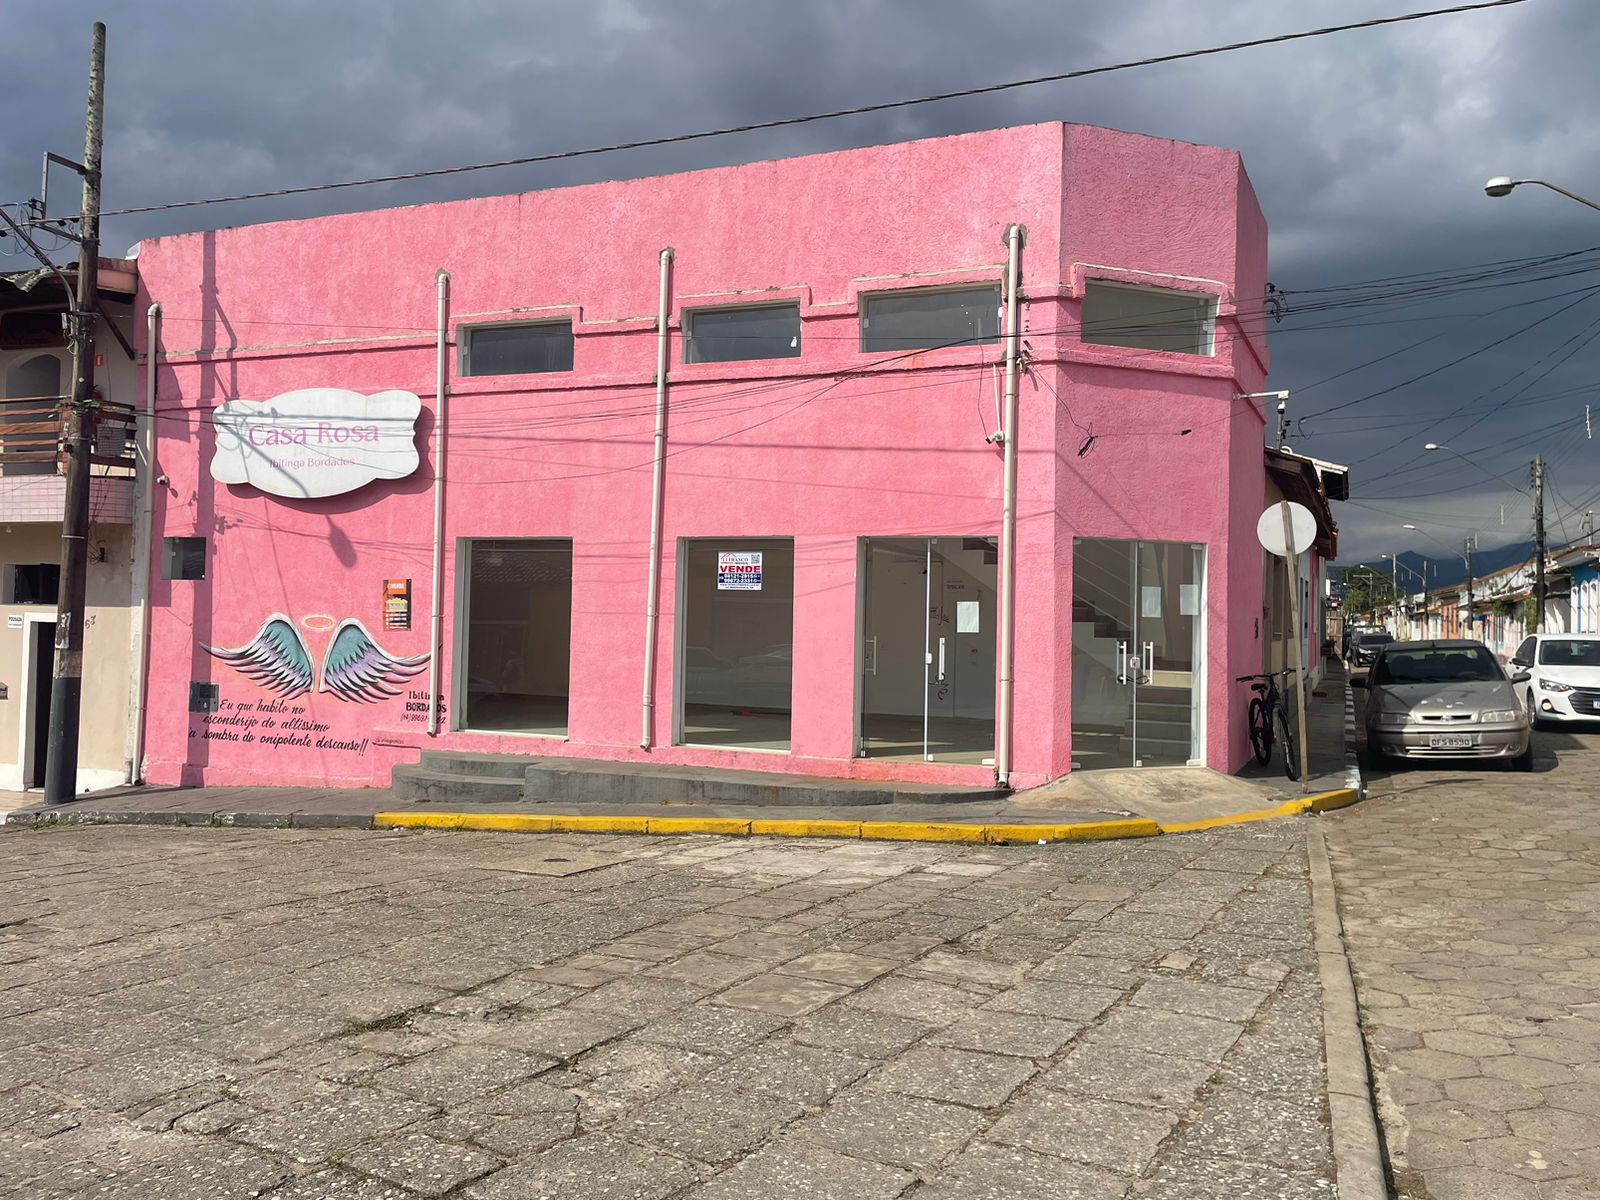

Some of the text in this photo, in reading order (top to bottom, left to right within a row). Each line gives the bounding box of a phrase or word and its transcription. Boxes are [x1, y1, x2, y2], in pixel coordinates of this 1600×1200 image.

[249, 422, 379, 447] Casa Rosa
[270, 457, 356, 470] Ibitinga Bordados
[720, 565, 761, 573] VENDE
[219, 698, 306, 715] Eu que habito no
[202, 714, 259, 731] esconderijo
[261, 716, 276, 728] do
[201, 728, 240, 742] sombra
[242, 731, 256, 743] do
[259, 731, 312, 750] onipotente
